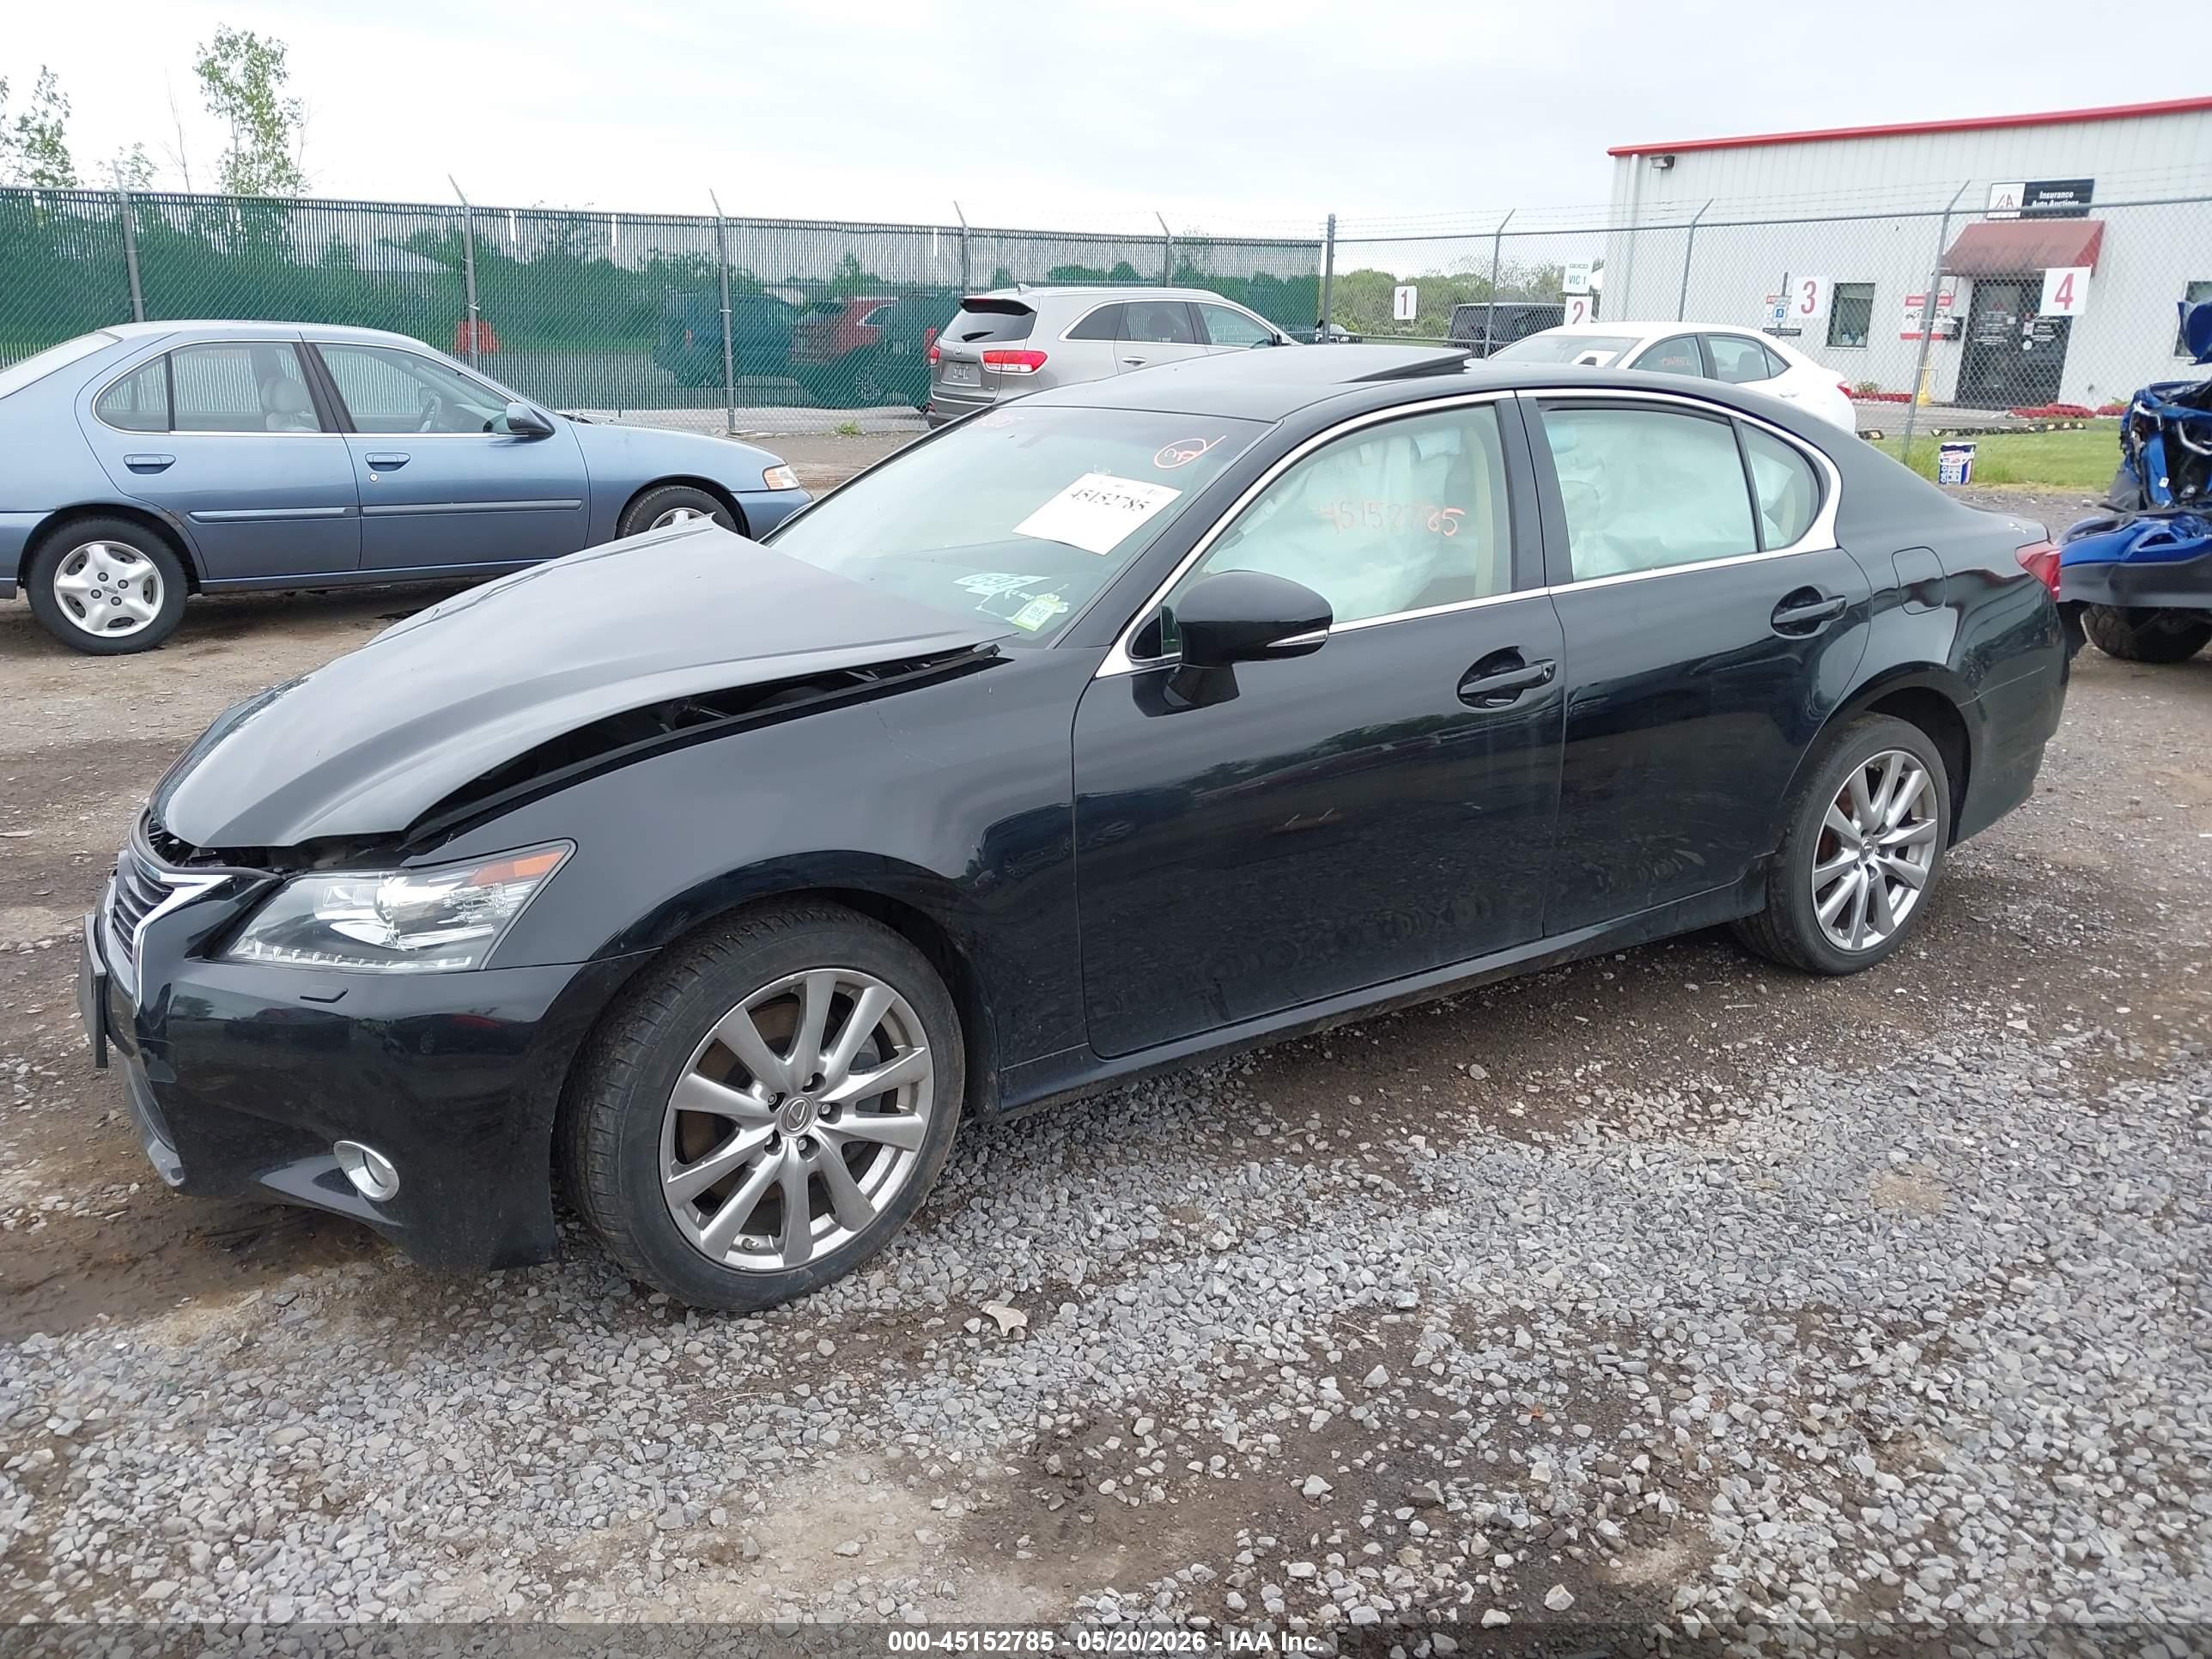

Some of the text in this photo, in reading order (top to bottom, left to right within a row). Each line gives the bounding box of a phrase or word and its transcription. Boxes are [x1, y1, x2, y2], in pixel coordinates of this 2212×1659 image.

[2039, 190, 2075, 199] Insurance
[1569, 275, 1587, 285] VIC 1
[2054, 272, 2075, 311] 4
[1401, 289, 1407, 316] 1
[1801, 280, 1817, 314] 3
[1572, 301, 1584, 325] 2
